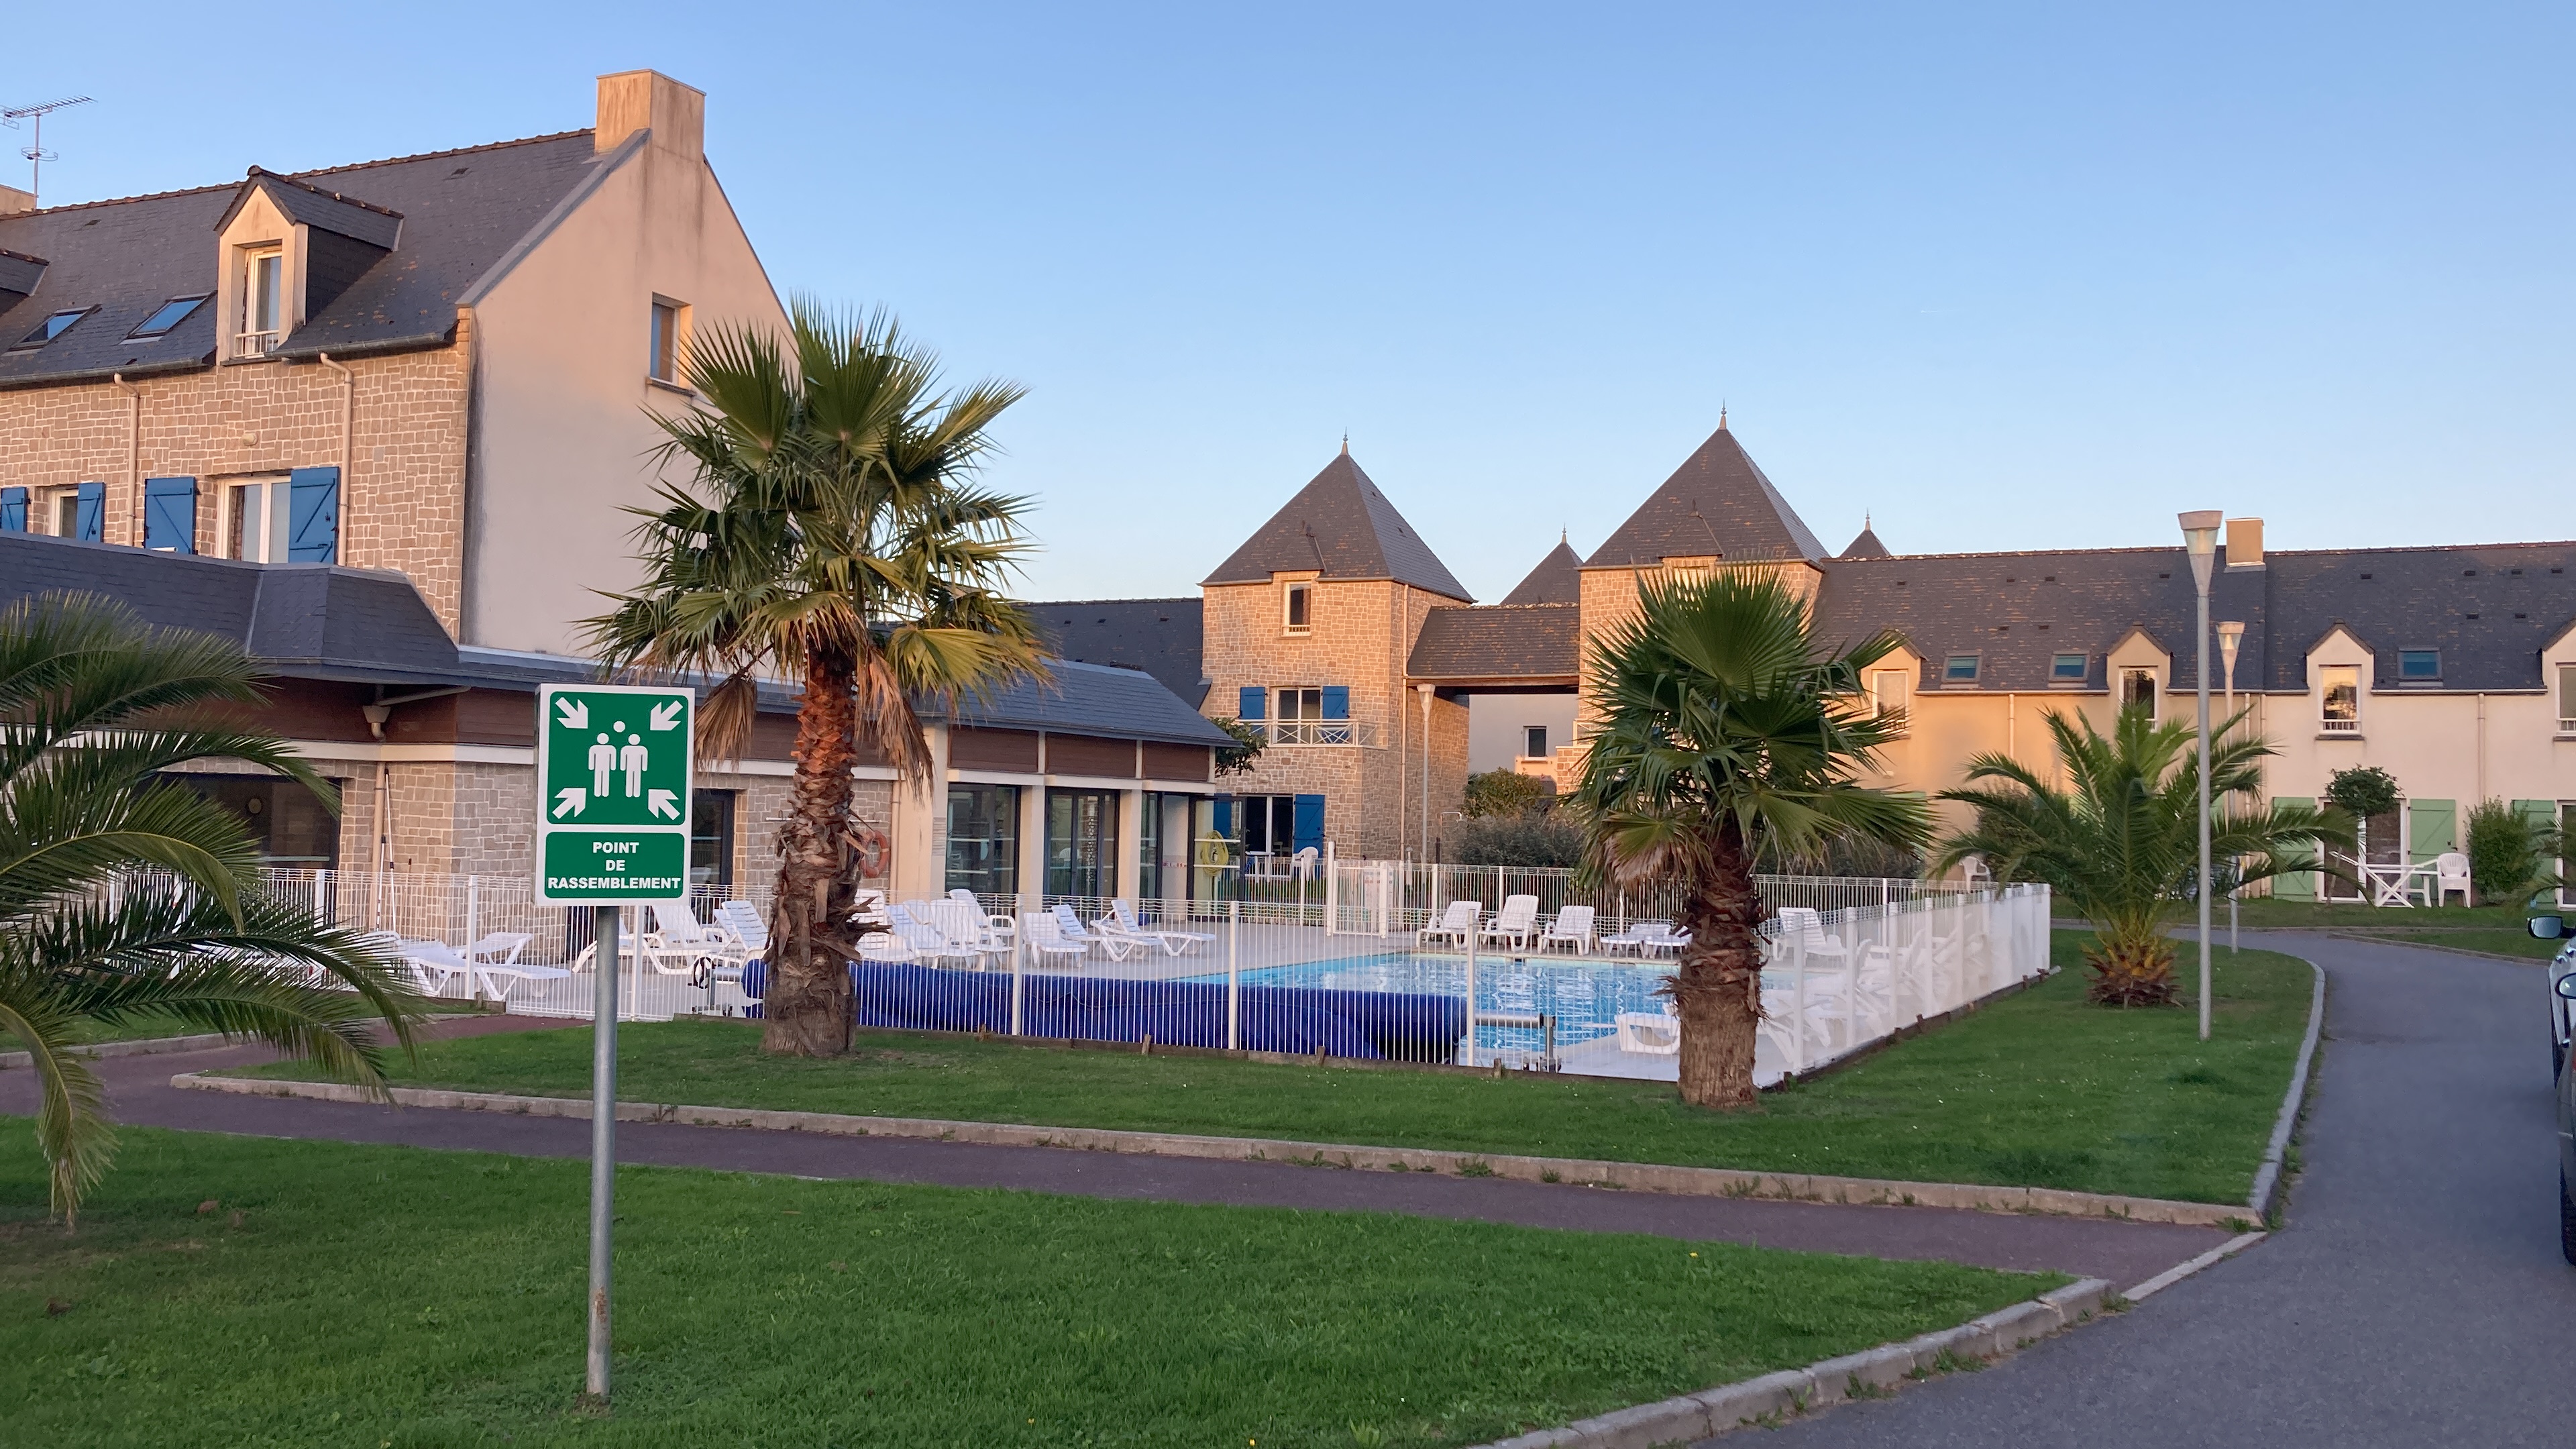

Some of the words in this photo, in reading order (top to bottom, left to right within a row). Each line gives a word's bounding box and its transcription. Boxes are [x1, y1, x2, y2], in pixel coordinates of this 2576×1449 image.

[592, 841, 639, 853] POINT
[605, 859, 626, 871] DE
[547, 877, 681, 889] RASSEMBLEMENT
